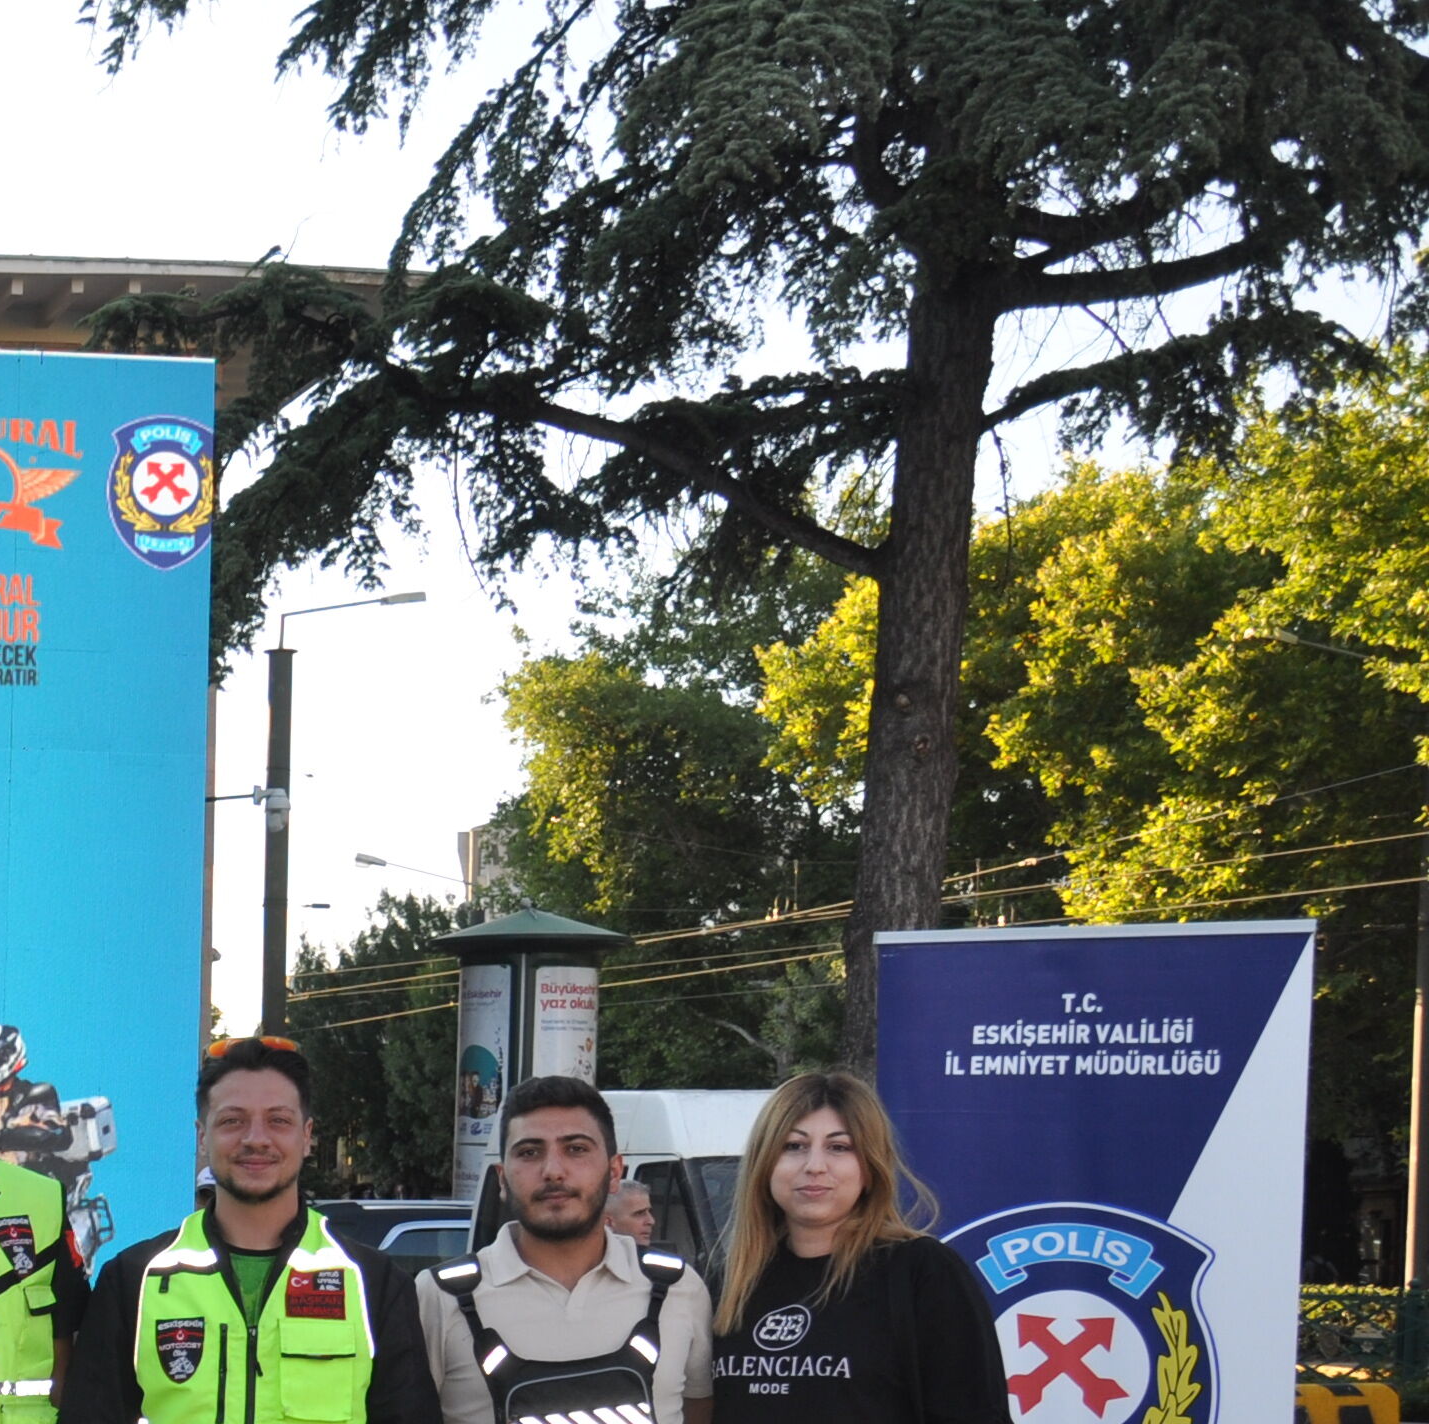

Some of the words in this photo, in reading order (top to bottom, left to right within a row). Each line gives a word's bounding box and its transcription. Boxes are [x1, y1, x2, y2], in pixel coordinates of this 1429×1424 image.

[540, 999, 567, 1011] yaz
[1061, 993, 1104, 1014] T.C.
[972, 1018, 1091, 1047] ESKİŞEHİR
[1095, 1017, 1194, 1044] VALİLİĞİ
[944, 1050, 966, 1076] İL
[969, 1049, 1070, 1076] EMNİYET
[1074, 1048, 1222, 1076] MÜDÜRLÜĞÜ
[1002, 1229, 1133, 1268] POLİS
[748, 1382, 790, 1395] MODE
